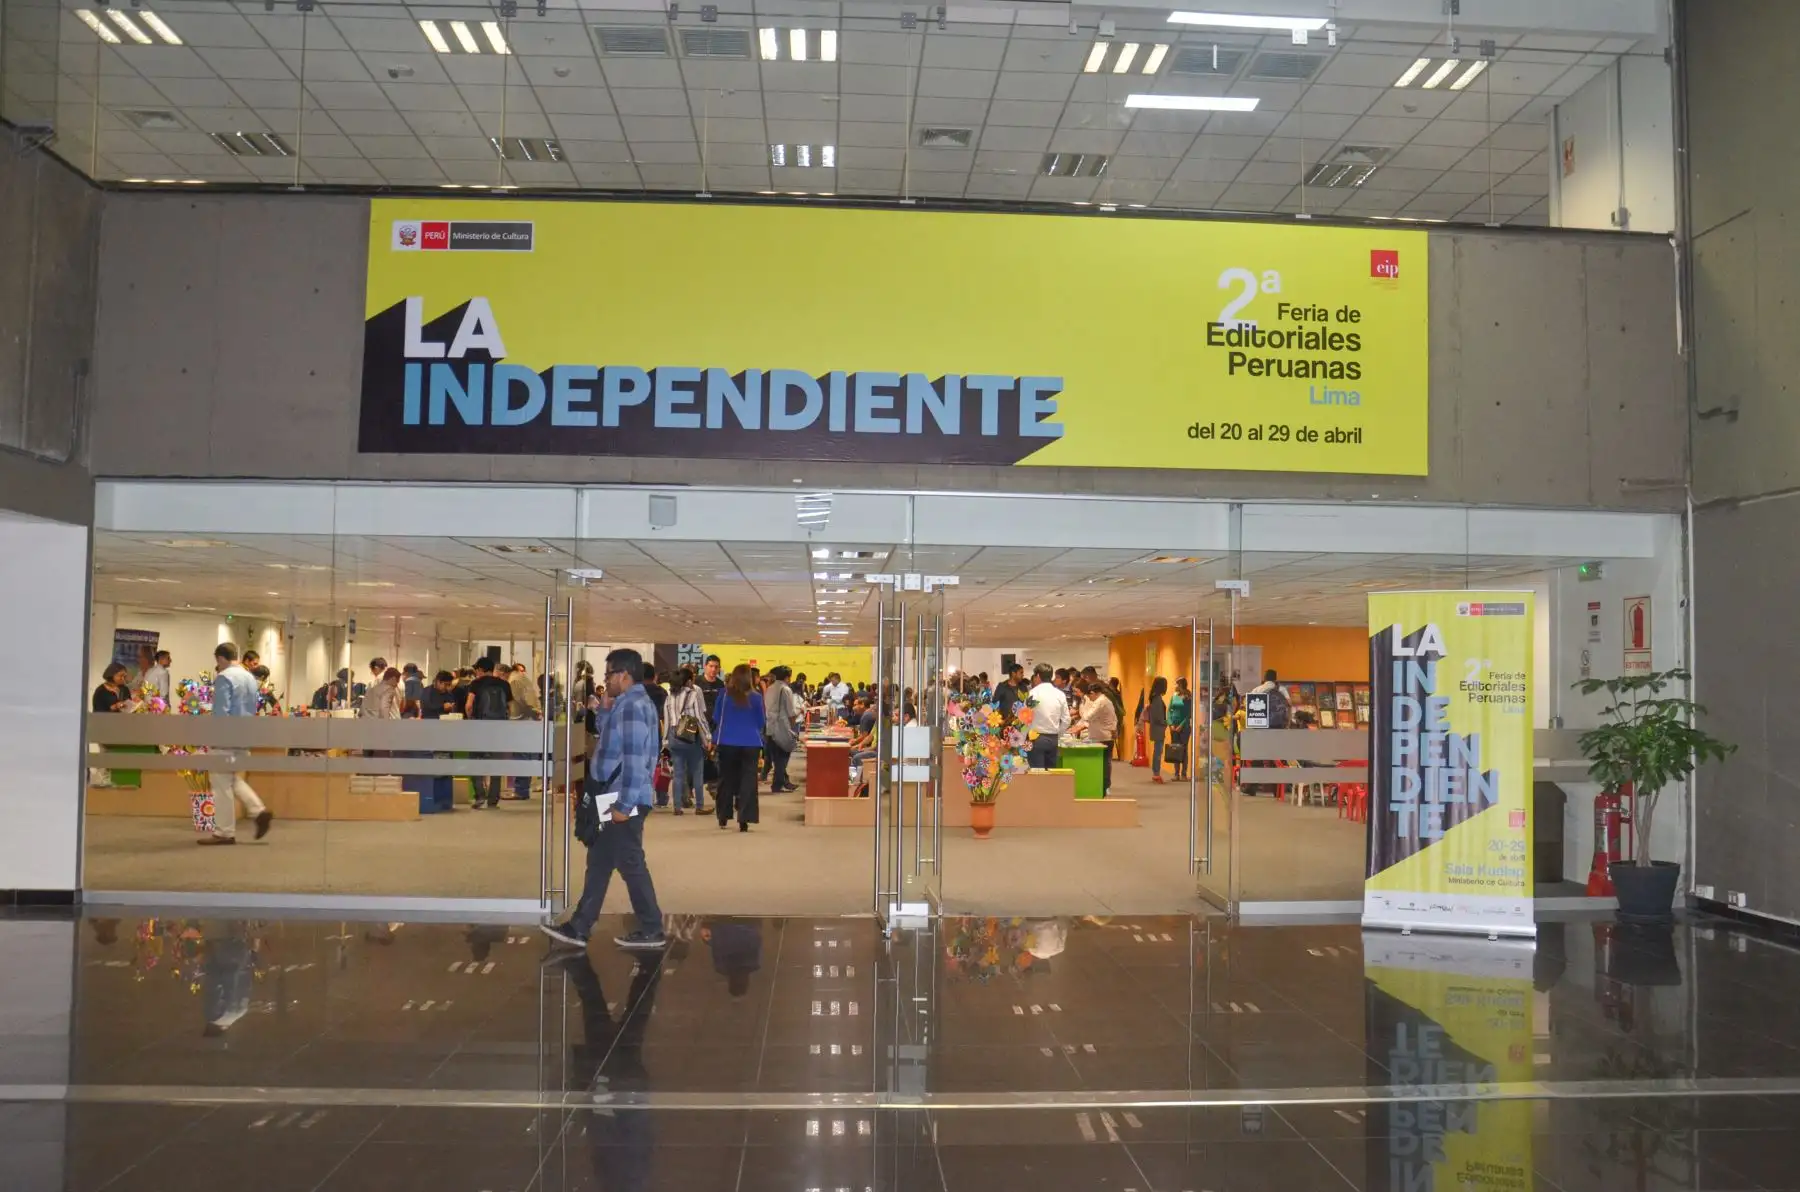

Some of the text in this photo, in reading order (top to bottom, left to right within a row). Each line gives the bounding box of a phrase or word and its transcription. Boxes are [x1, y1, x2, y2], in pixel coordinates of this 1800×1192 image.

[424, 231, 529, 240] PERÚ Ministerio de Cultura
[1377, 260, 1398, 278] eip
[403, 296, 507, 358] LA
[1277, 303, 1361, 323] Feria de
[1206, 322, 1361, 351] Editoriales
[1228, 351, 1361, 380] Peruanas
[403, 362, 1064, 437] INDEPENDIENTE
[1309, 386, 1361, 406] Lima
[1187, 422, 1362, 444] del 20 al 29 de abril
[1392, 624, 1448, 656] LA
[1392, 660, 1437, 694] IN
[1459, 681, 1526, 692] Editoriales
[1468, 693, 1526, 704] Peruanas
[1392, 696, 1450, 731] DE
[1392, 732, 1480, 767] PEN
[1391, 767, 1498, 804] DIEN
[1390, 804, 1445, 838] TE
